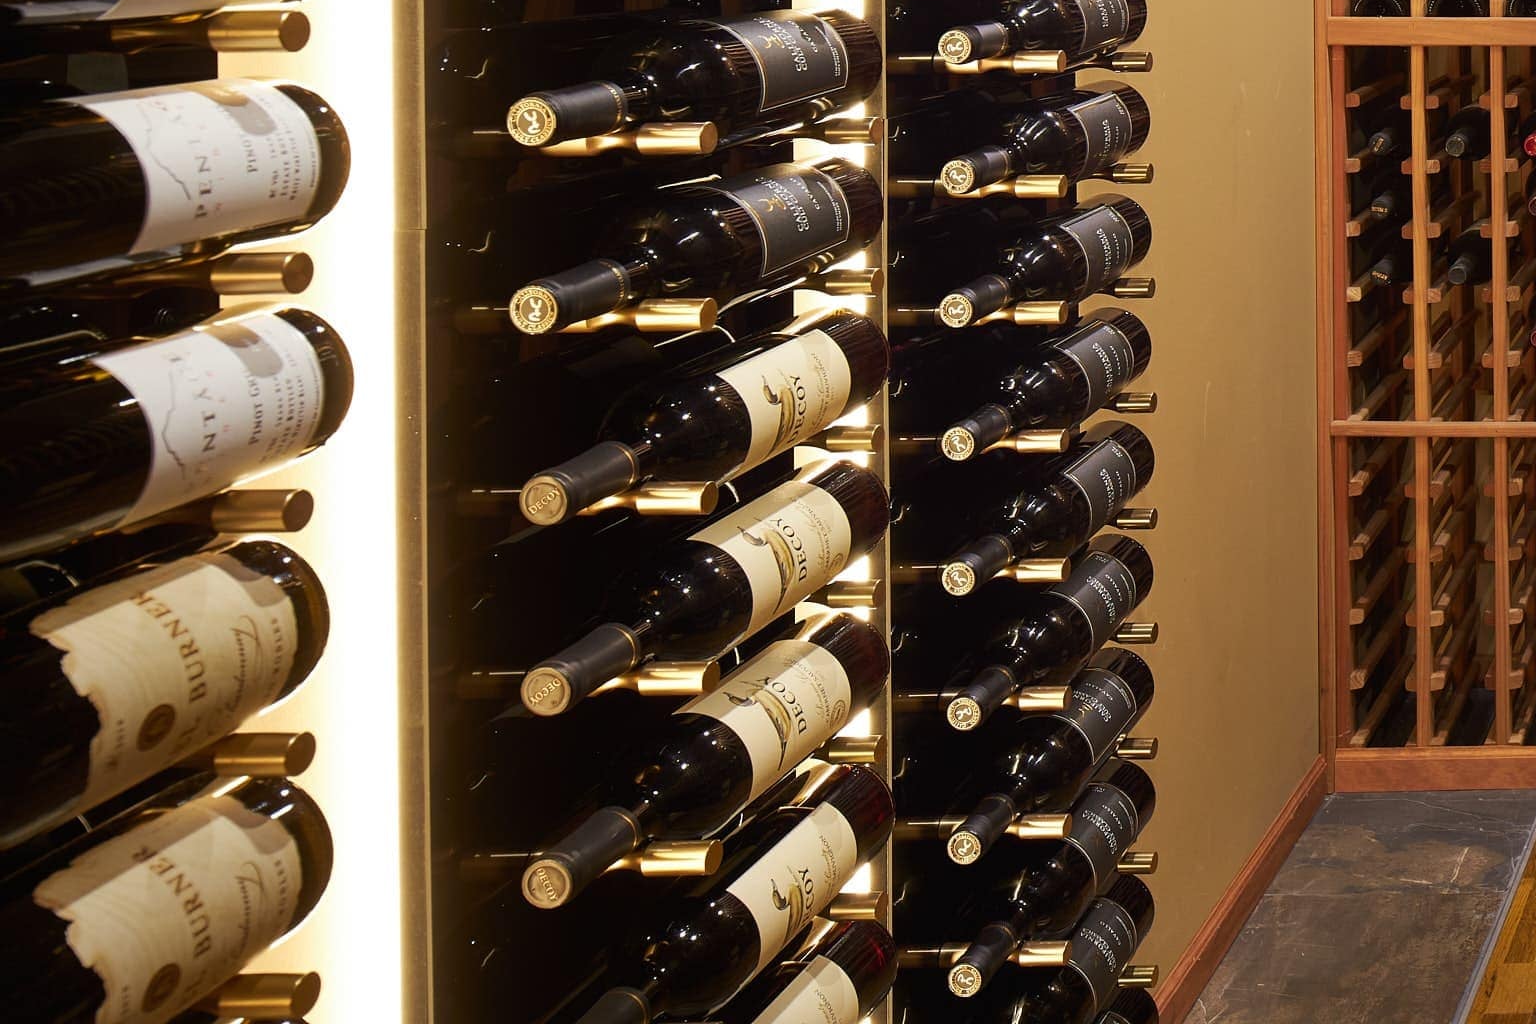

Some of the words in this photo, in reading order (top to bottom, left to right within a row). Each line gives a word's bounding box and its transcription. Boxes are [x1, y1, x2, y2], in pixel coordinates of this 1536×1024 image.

[528, 488, 561, 515] DECOY
[770, 518, 808, 582] DECOY
[530, 678, 562, 705] DECOY
[757, 676, 808, 735] DECOY
[536, 868, 559, 902] DECOY
[798, 868, 815, 923] COY
